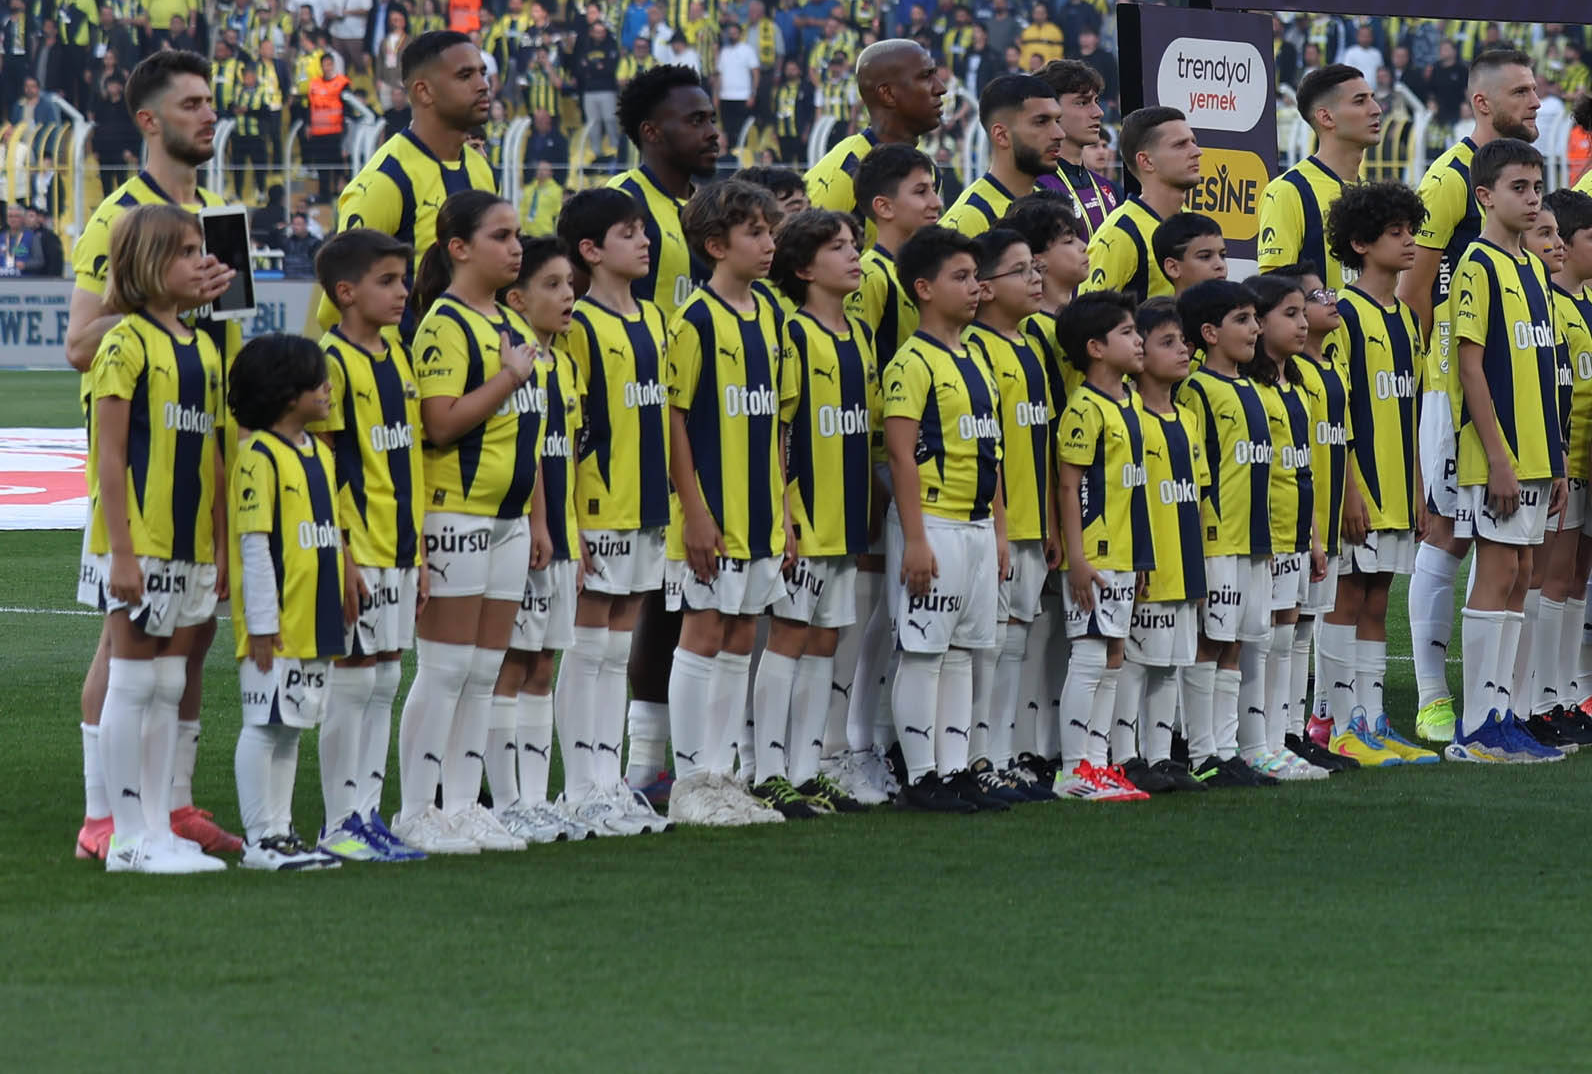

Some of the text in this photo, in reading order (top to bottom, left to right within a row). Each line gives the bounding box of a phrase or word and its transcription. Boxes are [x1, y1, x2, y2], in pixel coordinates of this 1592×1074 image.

[1177, 51, 1251, 88] trendyol
[1189, 90, 1237, 113] yemek
[1064, 442, 1089, 450] ALPET
[424, 525, 490, 554] pürsu
